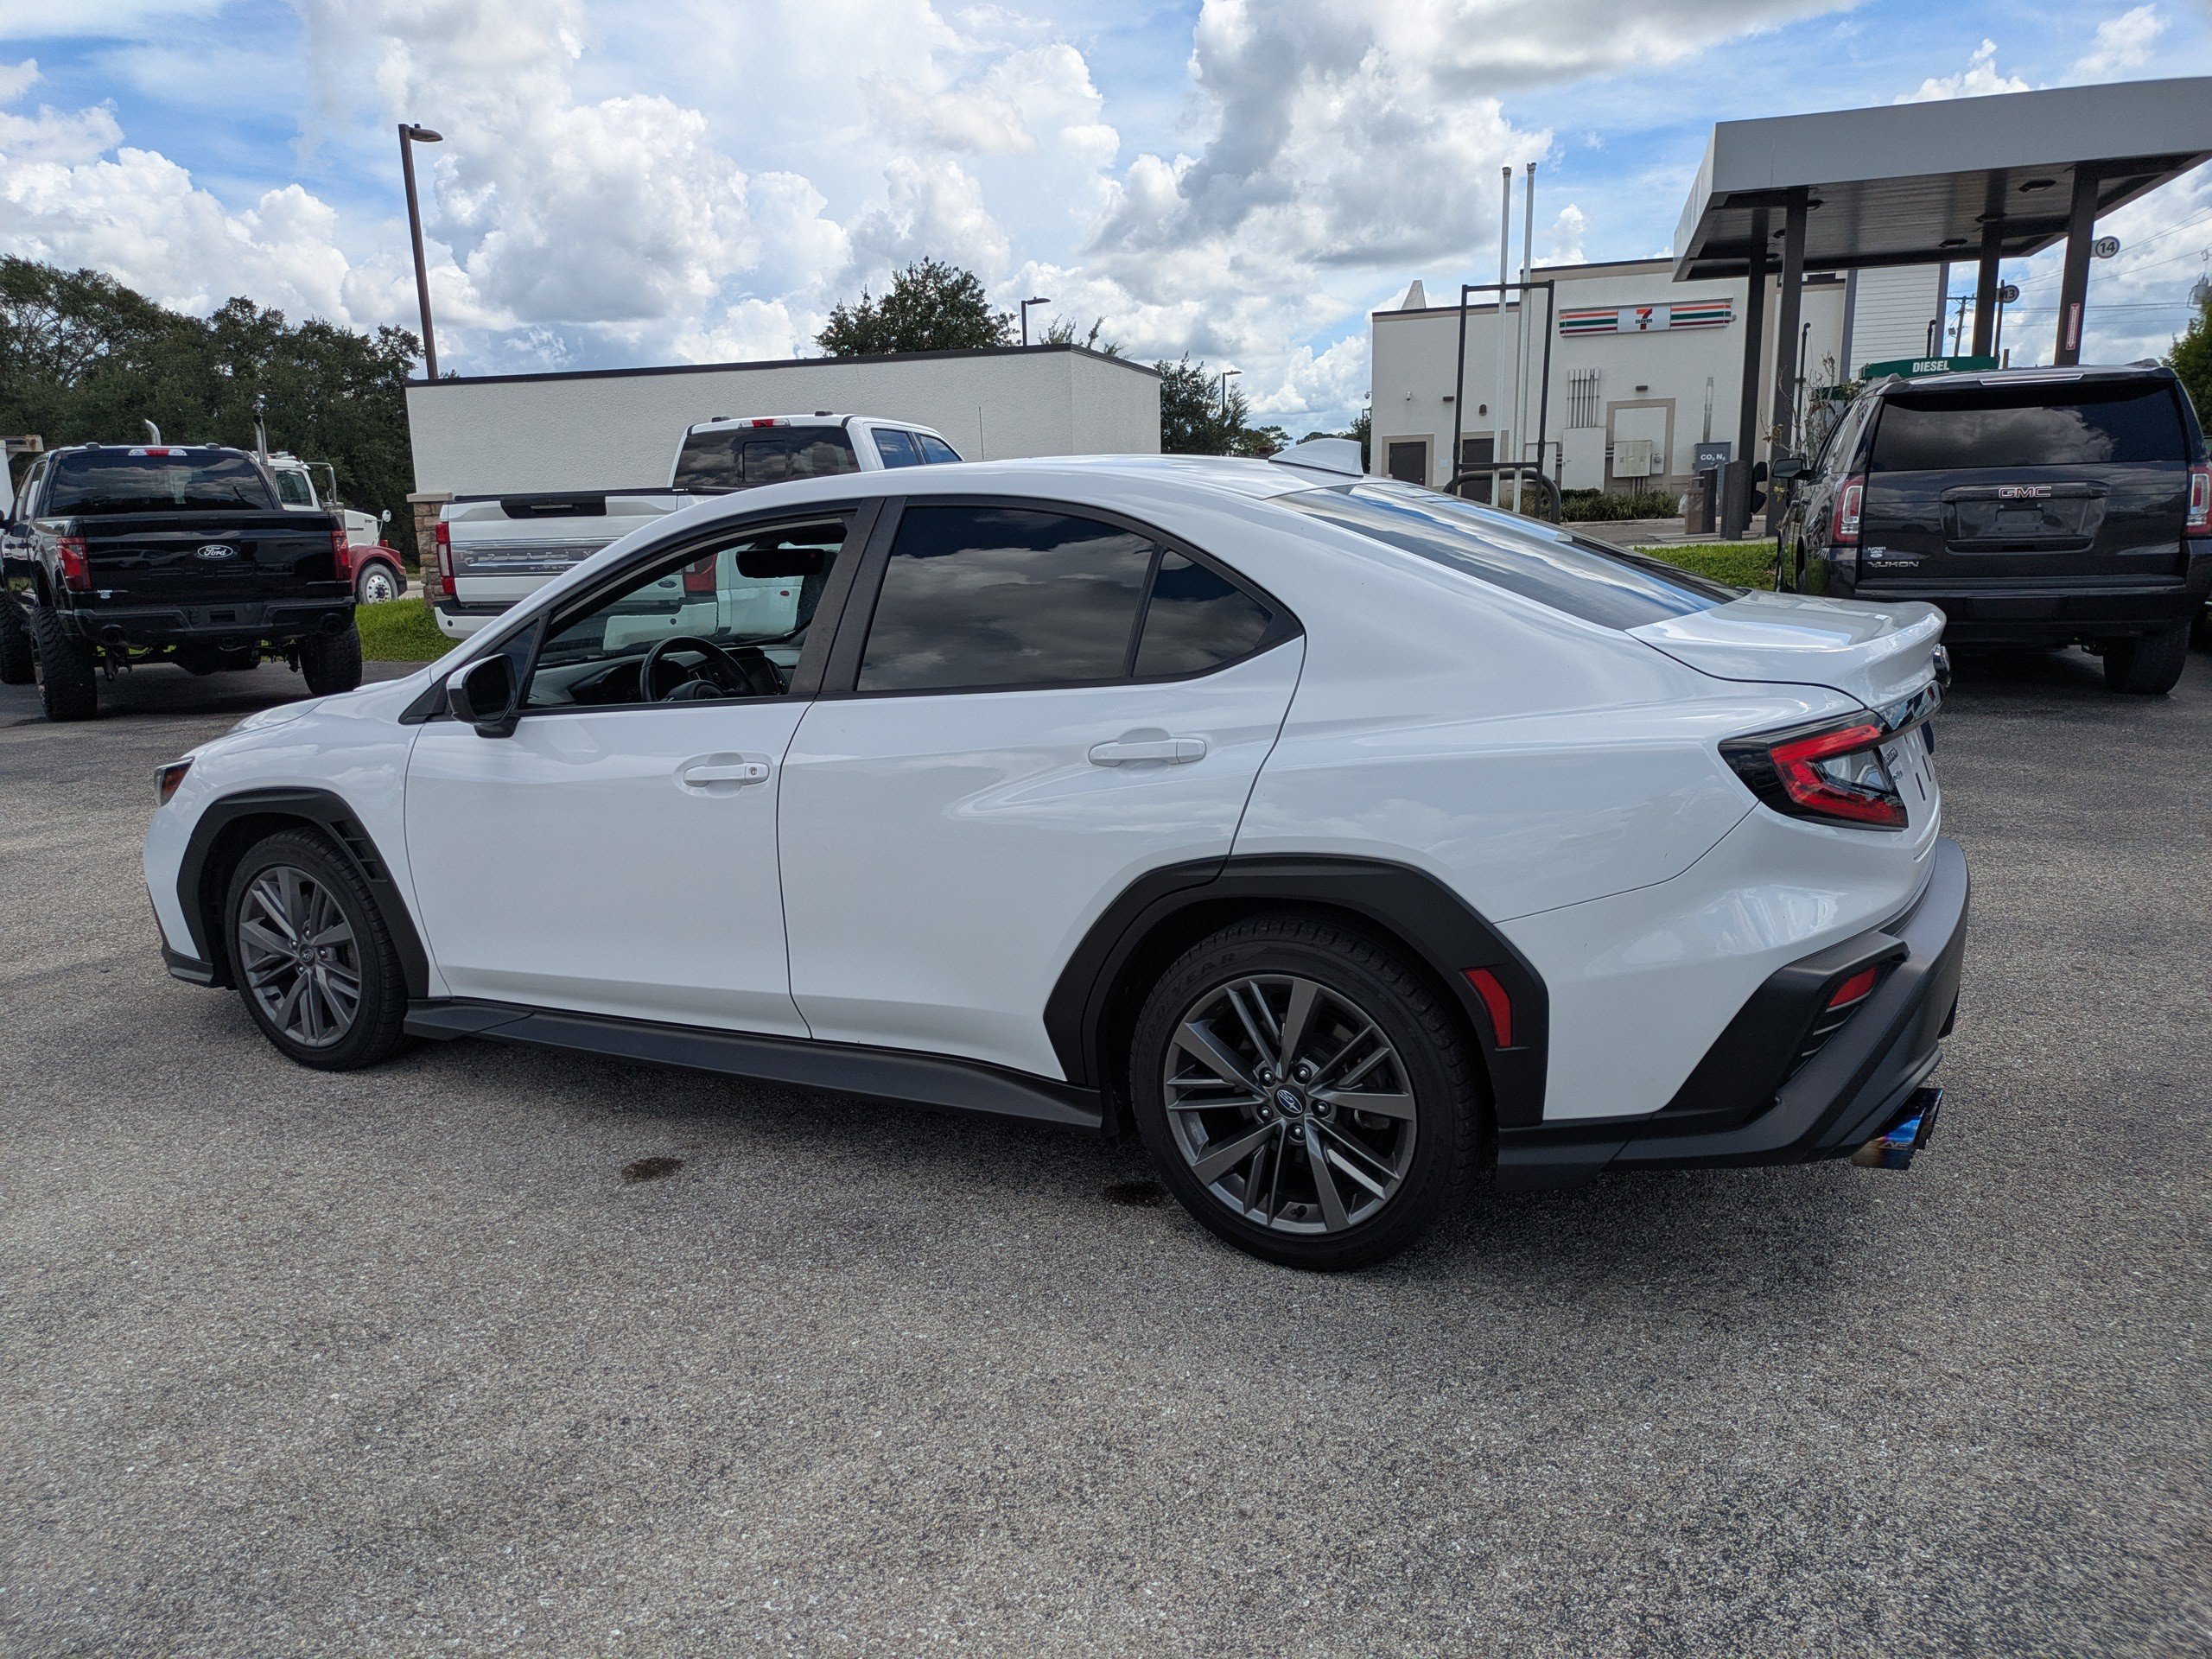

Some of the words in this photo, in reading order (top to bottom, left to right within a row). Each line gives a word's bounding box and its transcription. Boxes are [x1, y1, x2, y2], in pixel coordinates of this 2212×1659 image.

[2100, 242, 2115, 254] 14
[1636, 308, 1653, 329] 7
[1912, 360, 1949, 372] DIESEL
[1999, 486, 2051, 499] GMC
[204, 546, 226, 556] Ford
